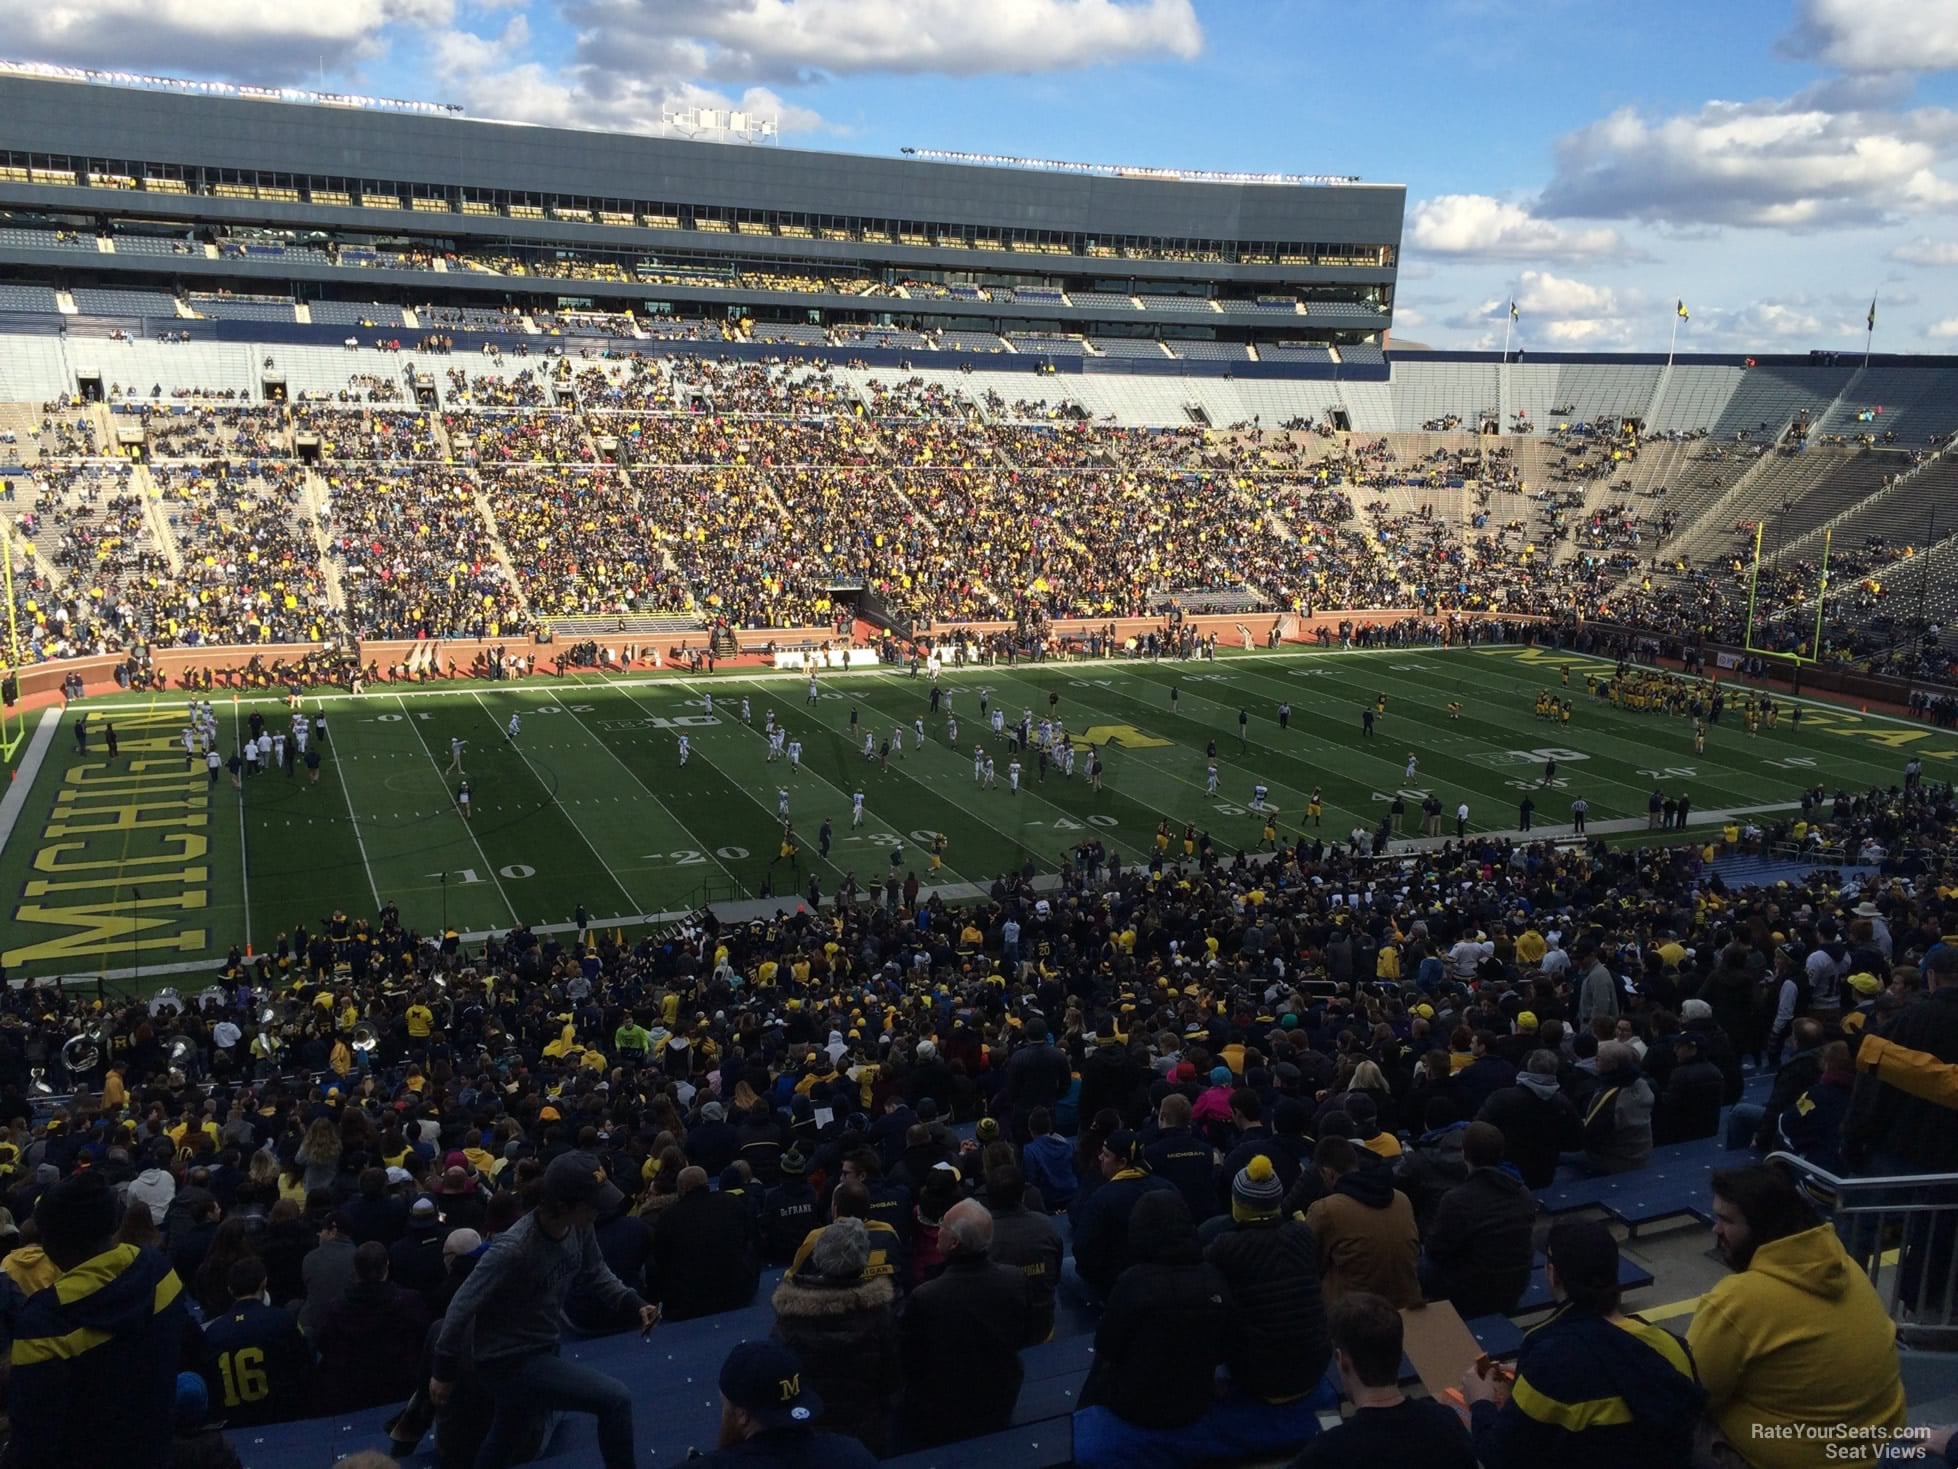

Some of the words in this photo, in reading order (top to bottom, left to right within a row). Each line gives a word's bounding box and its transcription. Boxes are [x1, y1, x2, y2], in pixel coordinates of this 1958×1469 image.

[376, 711, 436, 722] 10
[536, 704, 595, 714] 20
[1053, 815, 1119, 829] 40
[1, 709, 209, 968] MICHIGAN
[868, 830, 946, 846] 30
[675, 846, 750, 865] 20
[453, 864, 536, 884] 10
[217, 1346, 270, 1408] 16
[778, 1373, 801, 1400] M
